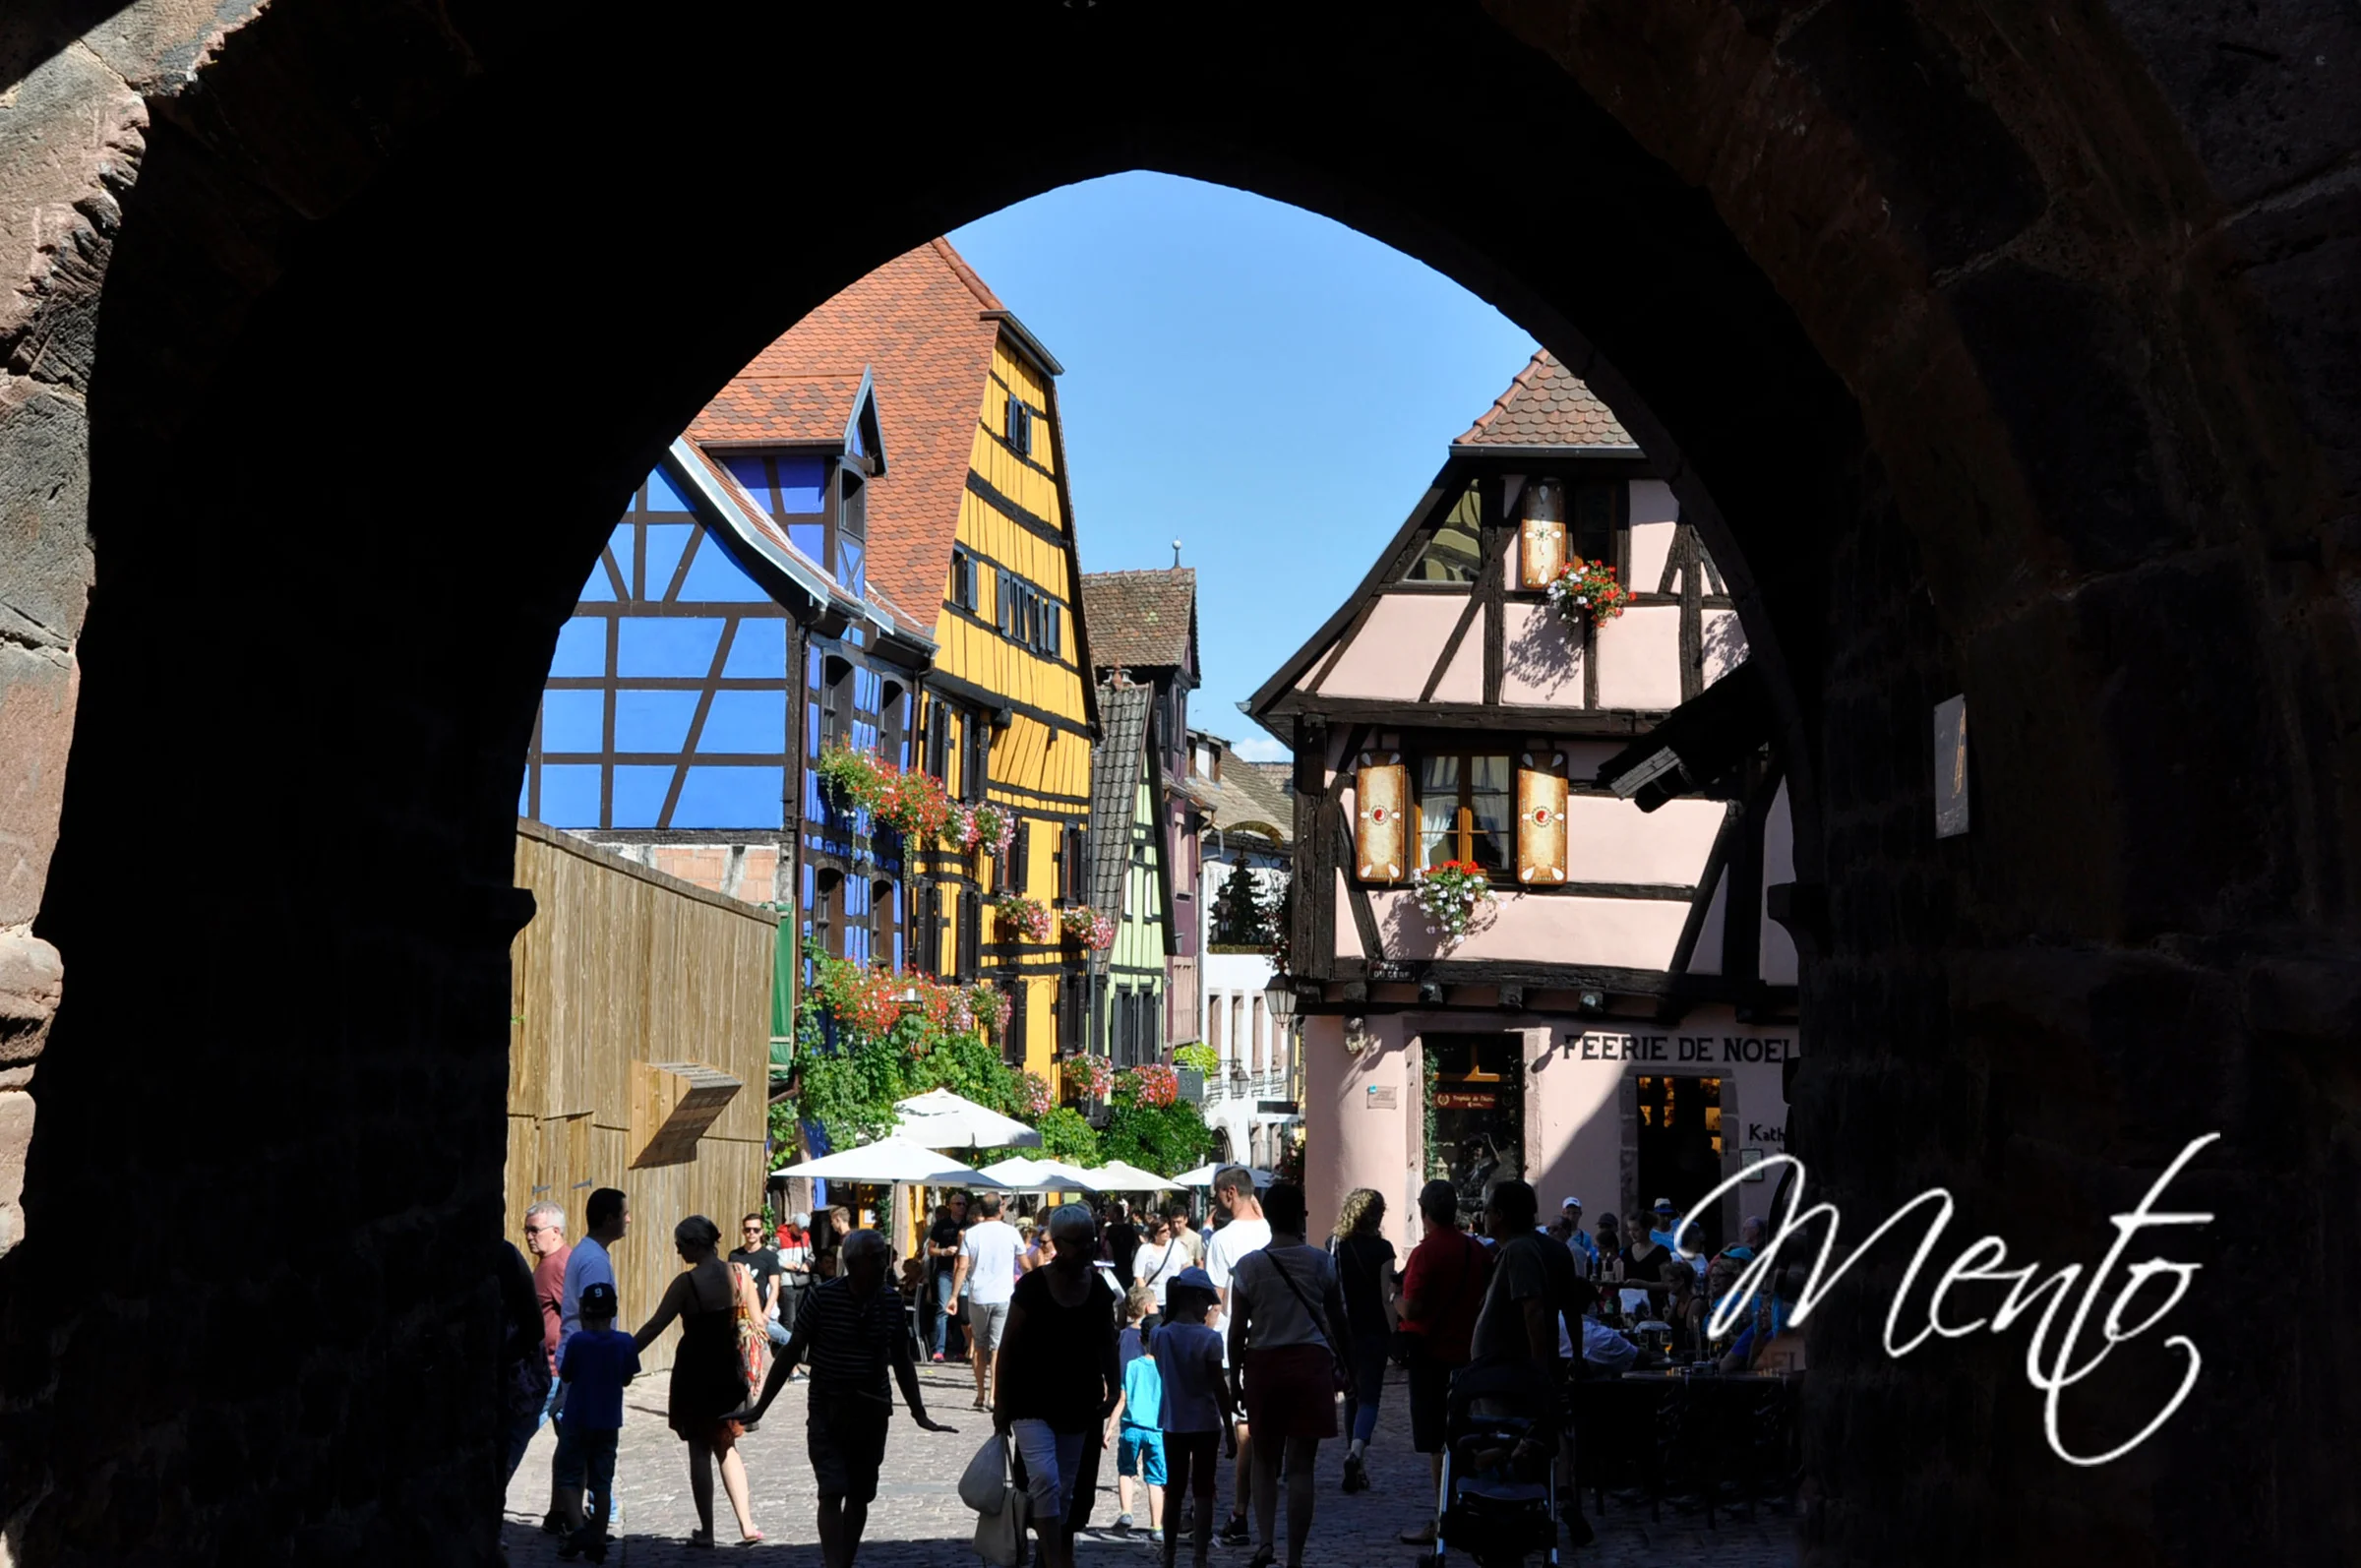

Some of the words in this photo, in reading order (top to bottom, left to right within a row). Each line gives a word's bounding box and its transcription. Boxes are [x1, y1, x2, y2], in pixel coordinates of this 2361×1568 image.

[1563, 1035, 1667, 1060] FEERIE
[1678, 1037, 1713, 1061] DE
[1723, 1038, 1791, 1062] NOEL
[594, 1287, 603, 1297] 9
